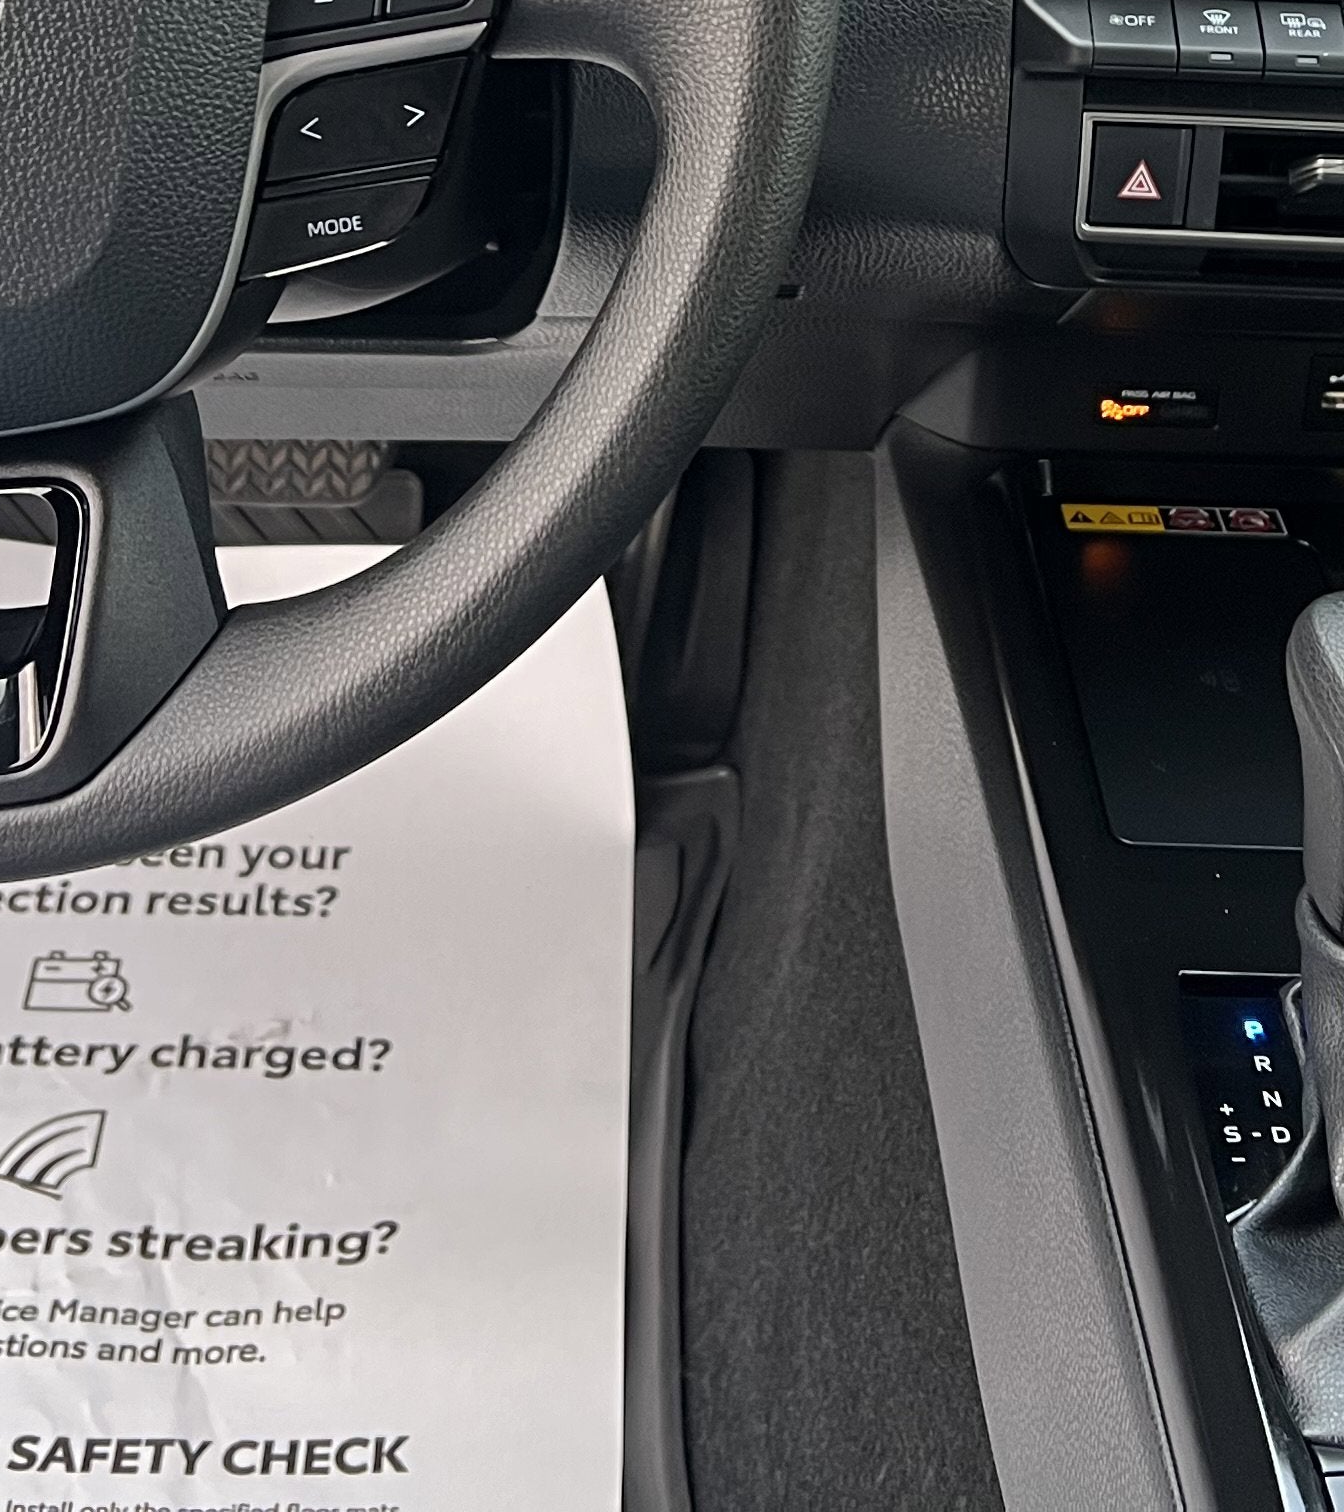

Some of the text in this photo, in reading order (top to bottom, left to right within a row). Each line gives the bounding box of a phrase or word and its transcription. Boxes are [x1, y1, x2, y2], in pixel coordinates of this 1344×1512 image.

[1124, 15, 1156, 27] OFF
[1199, 25, 1239, 35] FRONT
[1288, 29, 1321, 38] REAR
[307, 215, 363, 238] MODE
[238, 843, 352, 877] your
[146, 885, 340, 918] results?
[150, 1035, 393, 1079] charged?
[1253, 1055, 1272, 1072] R
[1262, 1090, 1283, 1108] N
[1223, 1125, 1242, 1143] S
[1271, 1126, 1291, 1143] D
[106, 1220, 400, 1266] streaking?
[49, 1300, 197, 1334] Manager
[205, 1308, 263, 1329] can
[273, 1296, 348, 1331] help
[97, 1336, 159, 1365] and
[170, 1343, 267, 1366] more.
[6, 1435, 213, 1475] SAFETY
[223, 1436, 412, 1475] CHECK
